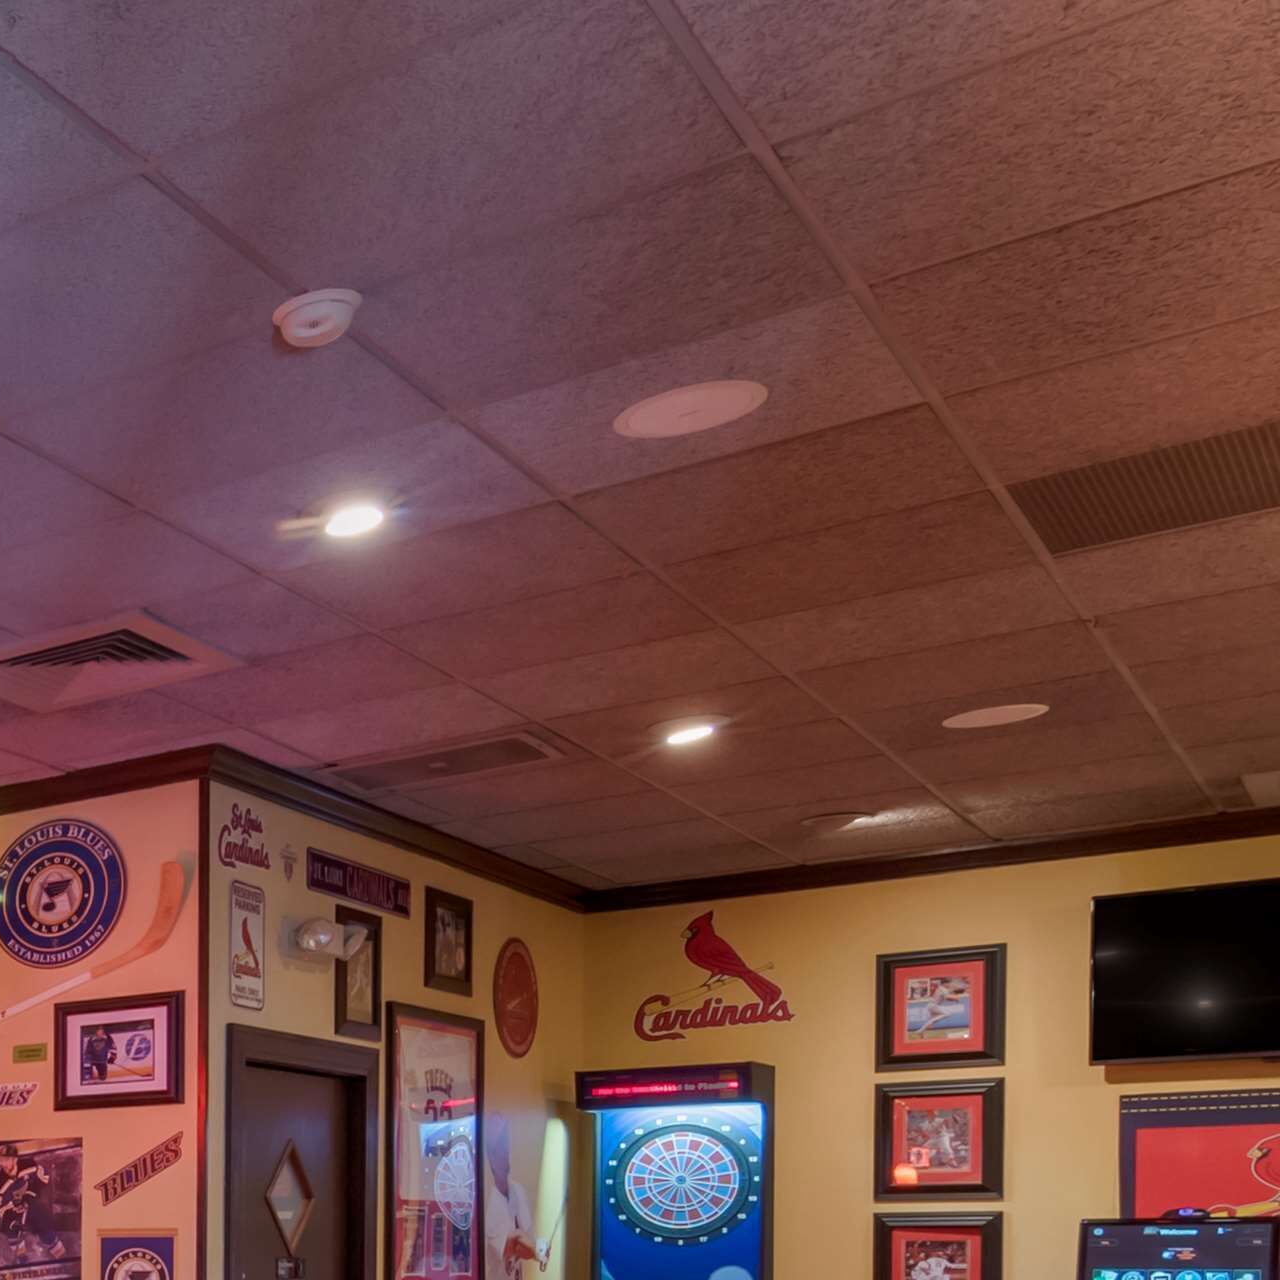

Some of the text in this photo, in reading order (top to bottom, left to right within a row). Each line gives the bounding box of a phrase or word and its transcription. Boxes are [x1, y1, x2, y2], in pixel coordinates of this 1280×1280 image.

[18, 823, 64, 854] LOUIS
[66, 824, 113, 861] BLUES
[218, 824, 271, 870] Cardinals
[6, 924, 106, 964] ESTABLISHED 1967
[634, 995, 796, 1042] Cardinals
[97, 1133, 181, 1204] BLUES
